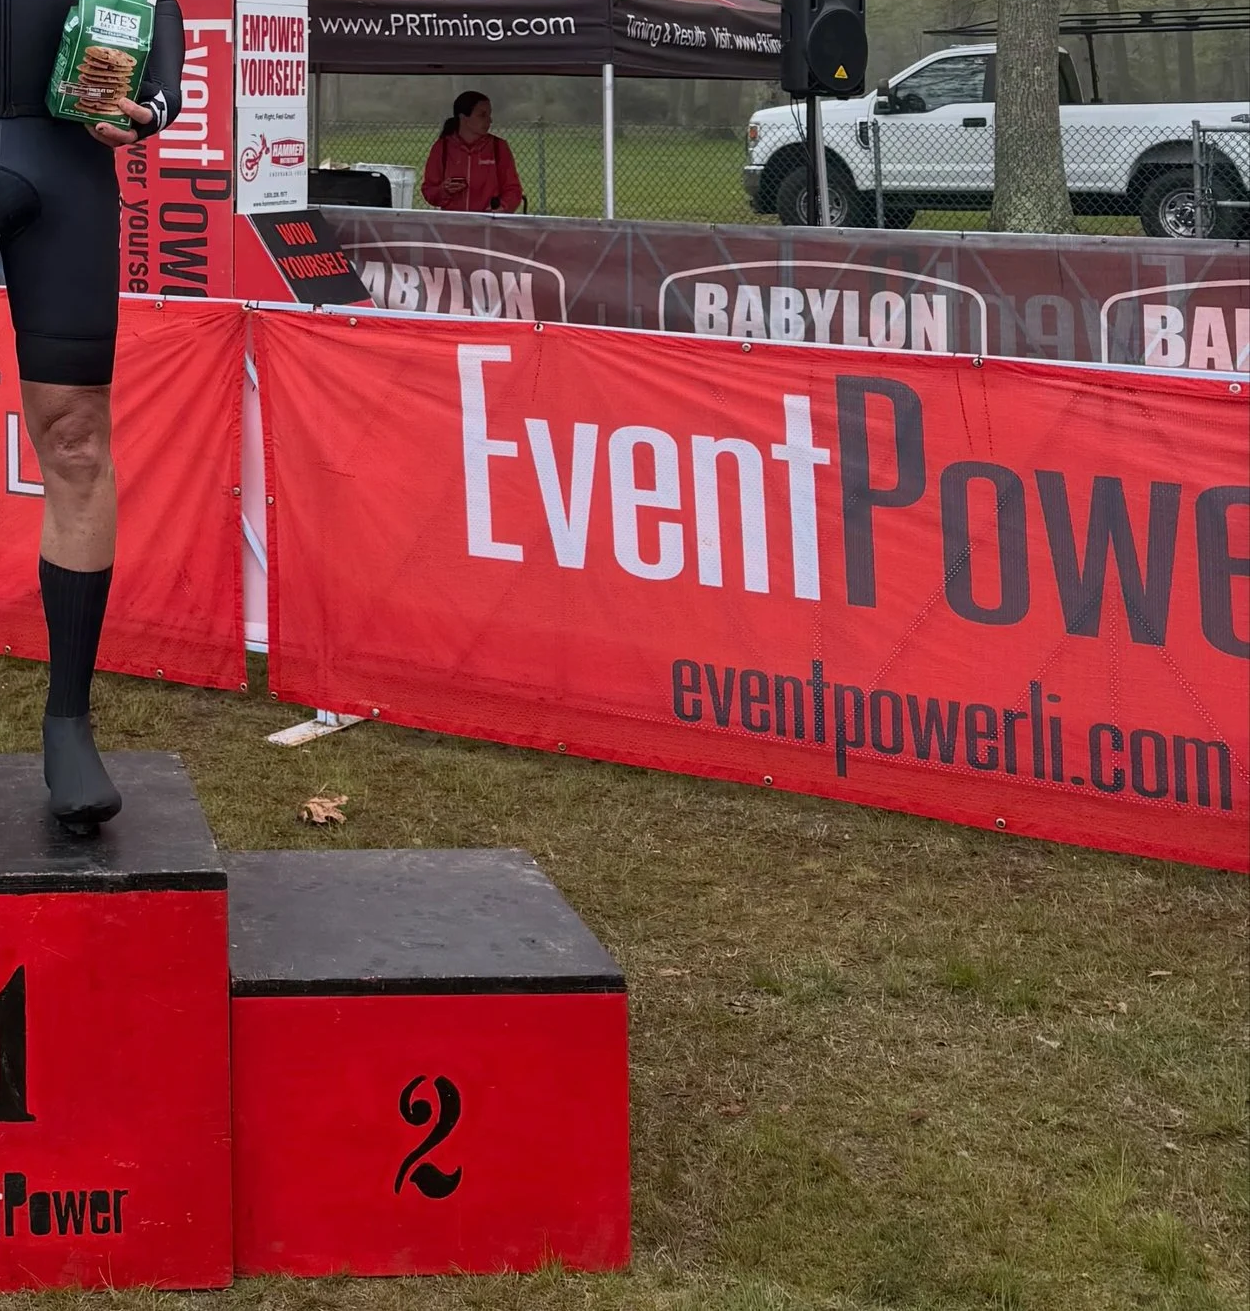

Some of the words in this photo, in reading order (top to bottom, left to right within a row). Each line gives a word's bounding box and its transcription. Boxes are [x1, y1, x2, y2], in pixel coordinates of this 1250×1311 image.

[97, 9, 138, 30] TATE'S
[242, 14, 305, 53] EMPOWER
[319, 13, 576, 41] www.PRTiming.com
[626, 14, 663, 47] Timing
[663, 22, 672, 41] &
[673, 23, 707, 48] Results
[241, 58, 305, 96] YOURSELF!
[275, 221, 318, 246] WOW
[278, 251, 350, 280] YOURSELF
[354, 260, 535, 321] ABYLON
[694, 281, 948, 353] BABYLON
[457, 343, 1250, 660] EventPowe
[672, 658, 1233, 811] eventpowerli.com
[393, 1073, 464, 1201] 2
